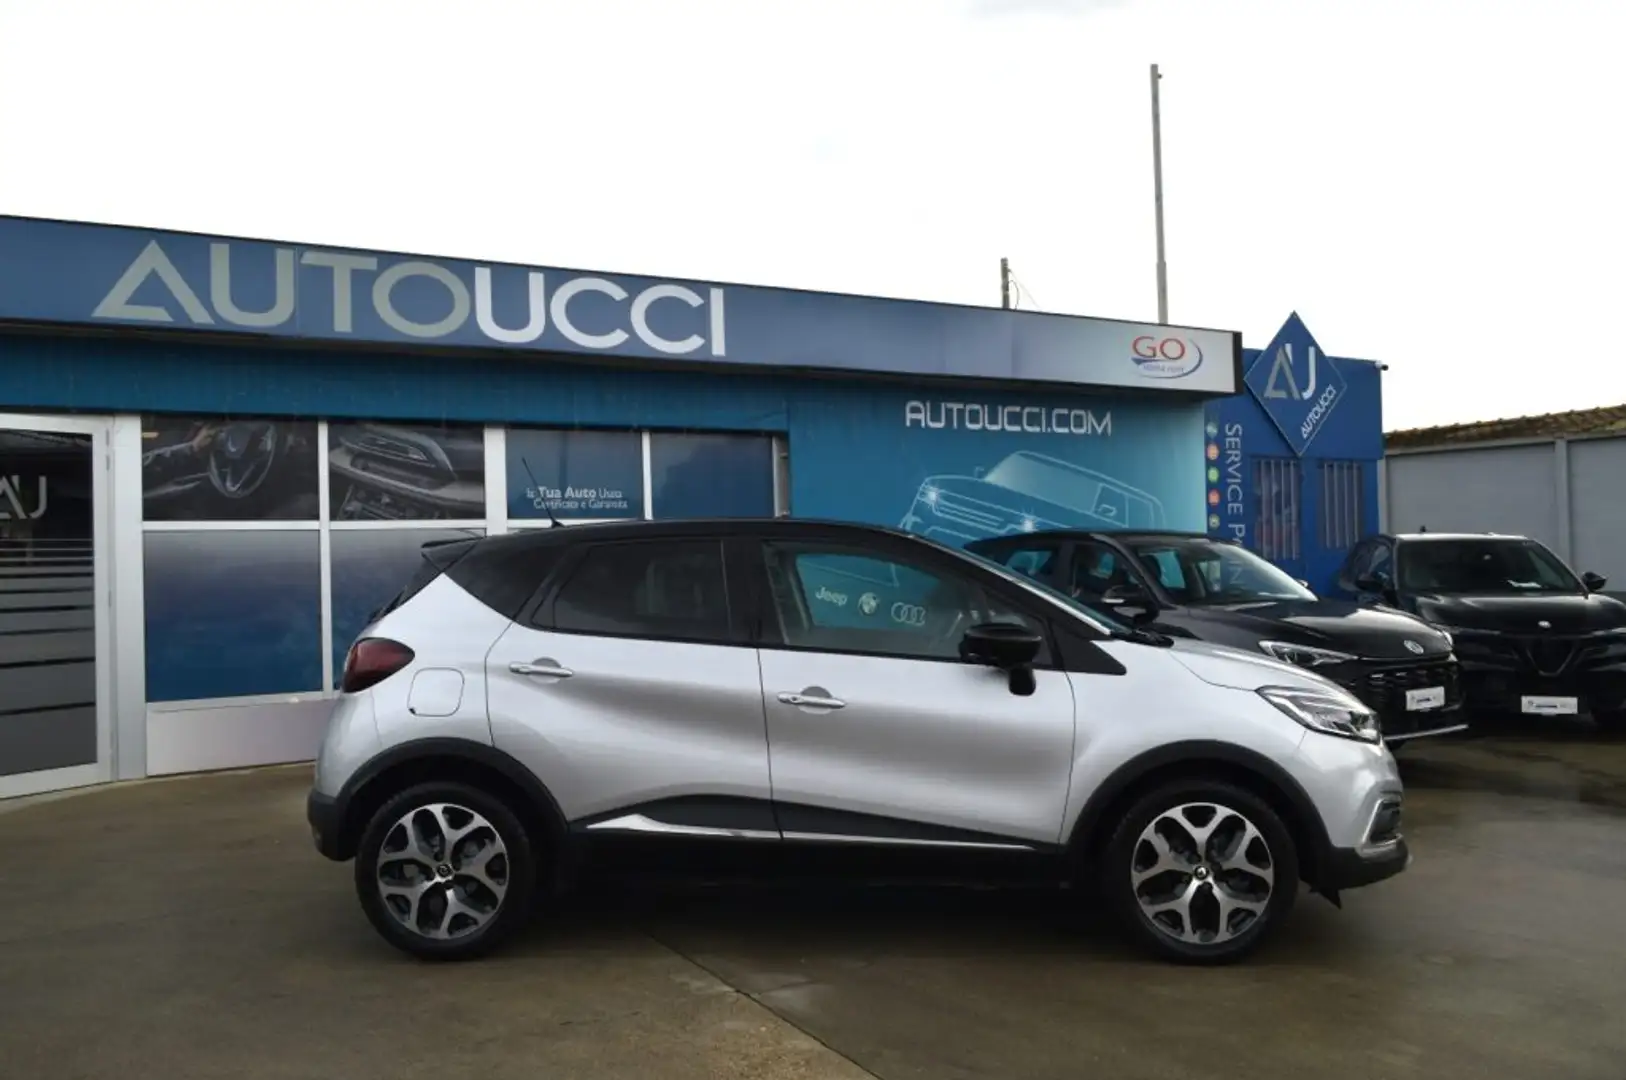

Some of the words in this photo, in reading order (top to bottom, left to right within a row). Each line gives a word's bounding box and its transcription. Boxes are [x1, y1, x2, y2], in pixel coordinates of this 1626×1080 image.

[91, 239, 727, 358] AUTOUCCI
[1132, 335, 1186, 361] GO
[905, 399, 1113, 437] AUTOUCCI.COM
[1301, 383, 1337, 440] AUTOUCCI
[1225, 422, 1244, 516] SERVICE
[538, 486, 562, 499] Tua
[564, 485, 597, 499] Auto
[815, 586, 848, 607] Jeep
